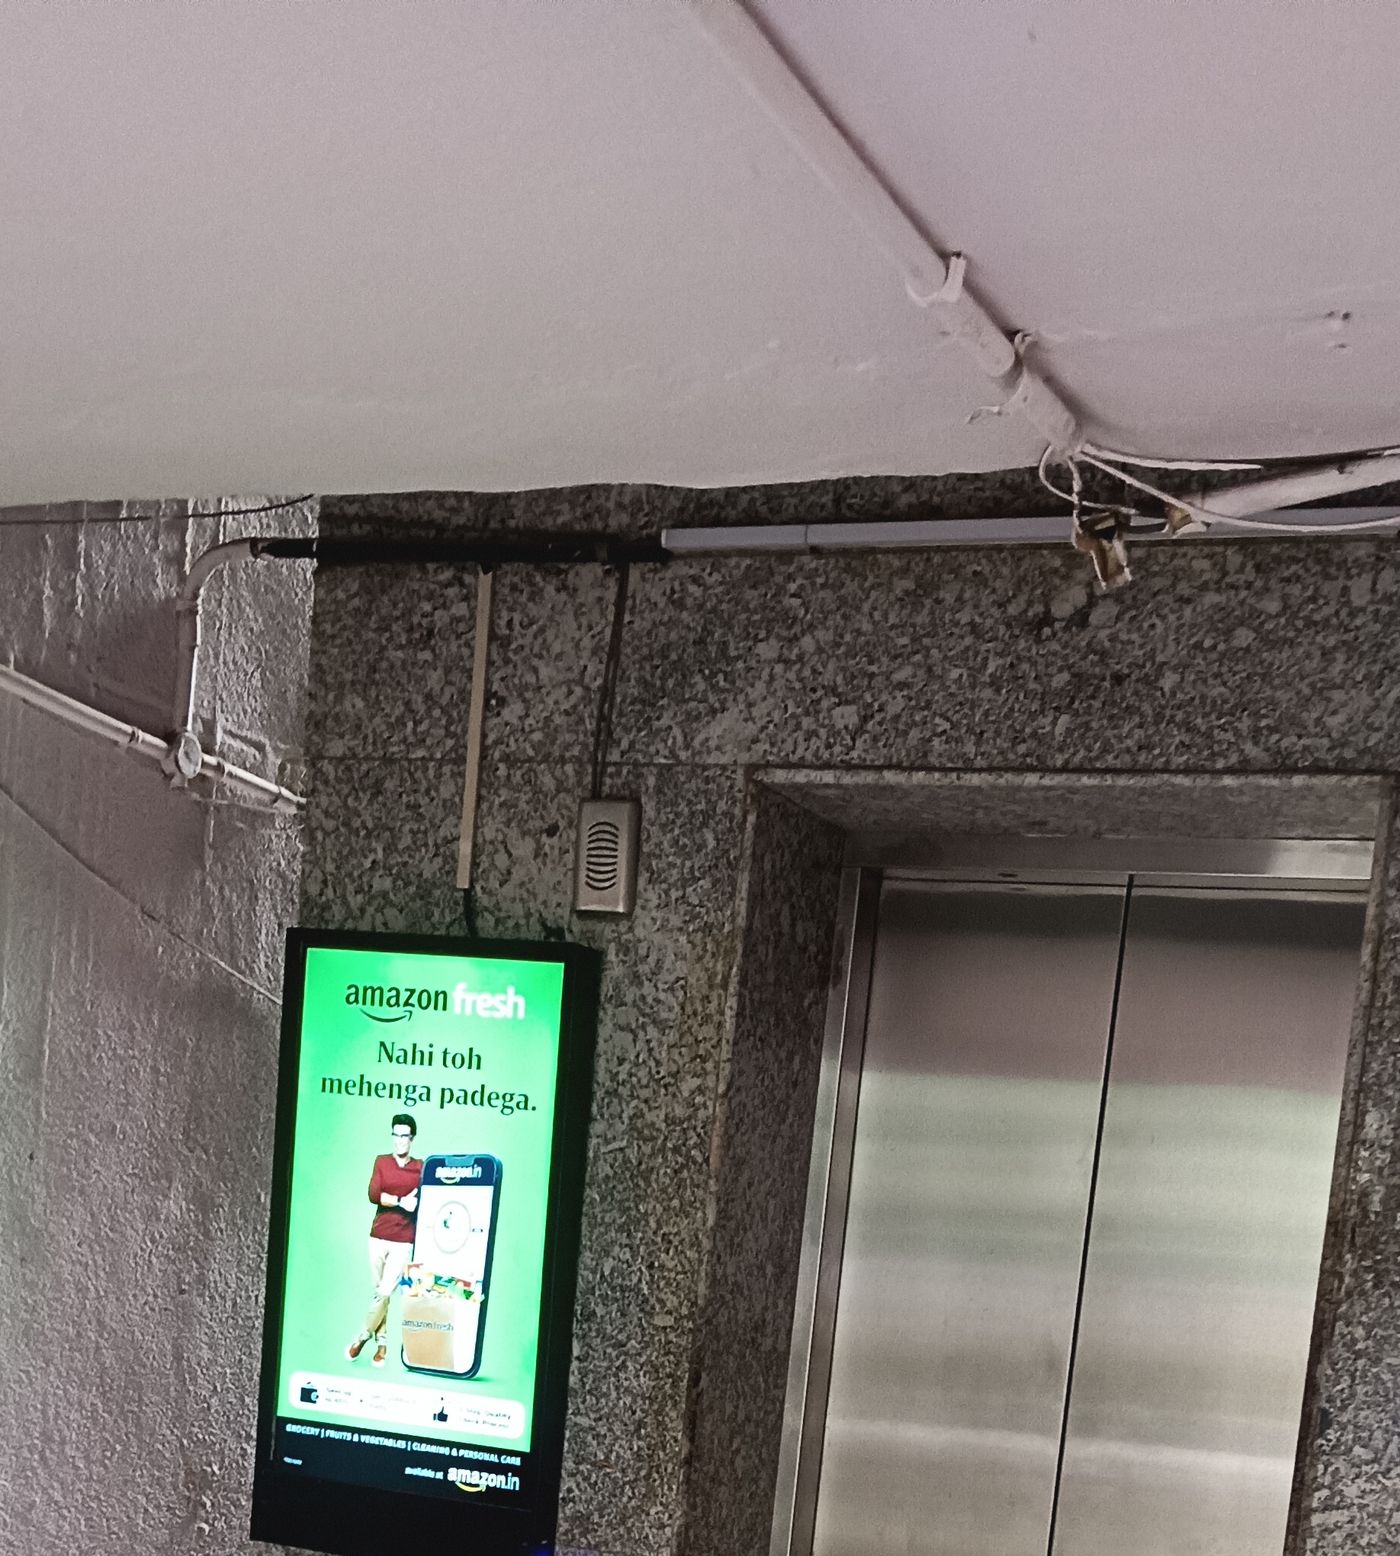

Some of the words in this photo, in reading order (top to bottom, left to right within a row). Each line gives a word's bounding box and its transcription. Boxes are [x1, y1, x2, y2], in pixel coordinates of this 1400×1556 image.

[345, 983, 448, 1023] amazon
[452, 982, 526, 1020] fresh
[377, 1041, 435, 1067] Nahi
[441, 1047, 482, 1070] toh
[320, 1074, 431, 1107] mehenga
[439, 1084, 537, 1116] padega.
[285, 1423, 320, 1436] GROCERY
[325, 1429, 352, 1441] FRUITS
[360, 1434, 407, 1449] VEGETABLES
[412, 1441, 450, 1456] CLEANING
[458, 1448, 500, 1463] PERSONAL
[500, 1455, 521, 1466] CARE
[447, 1466, 520, 1492] amazon.in
